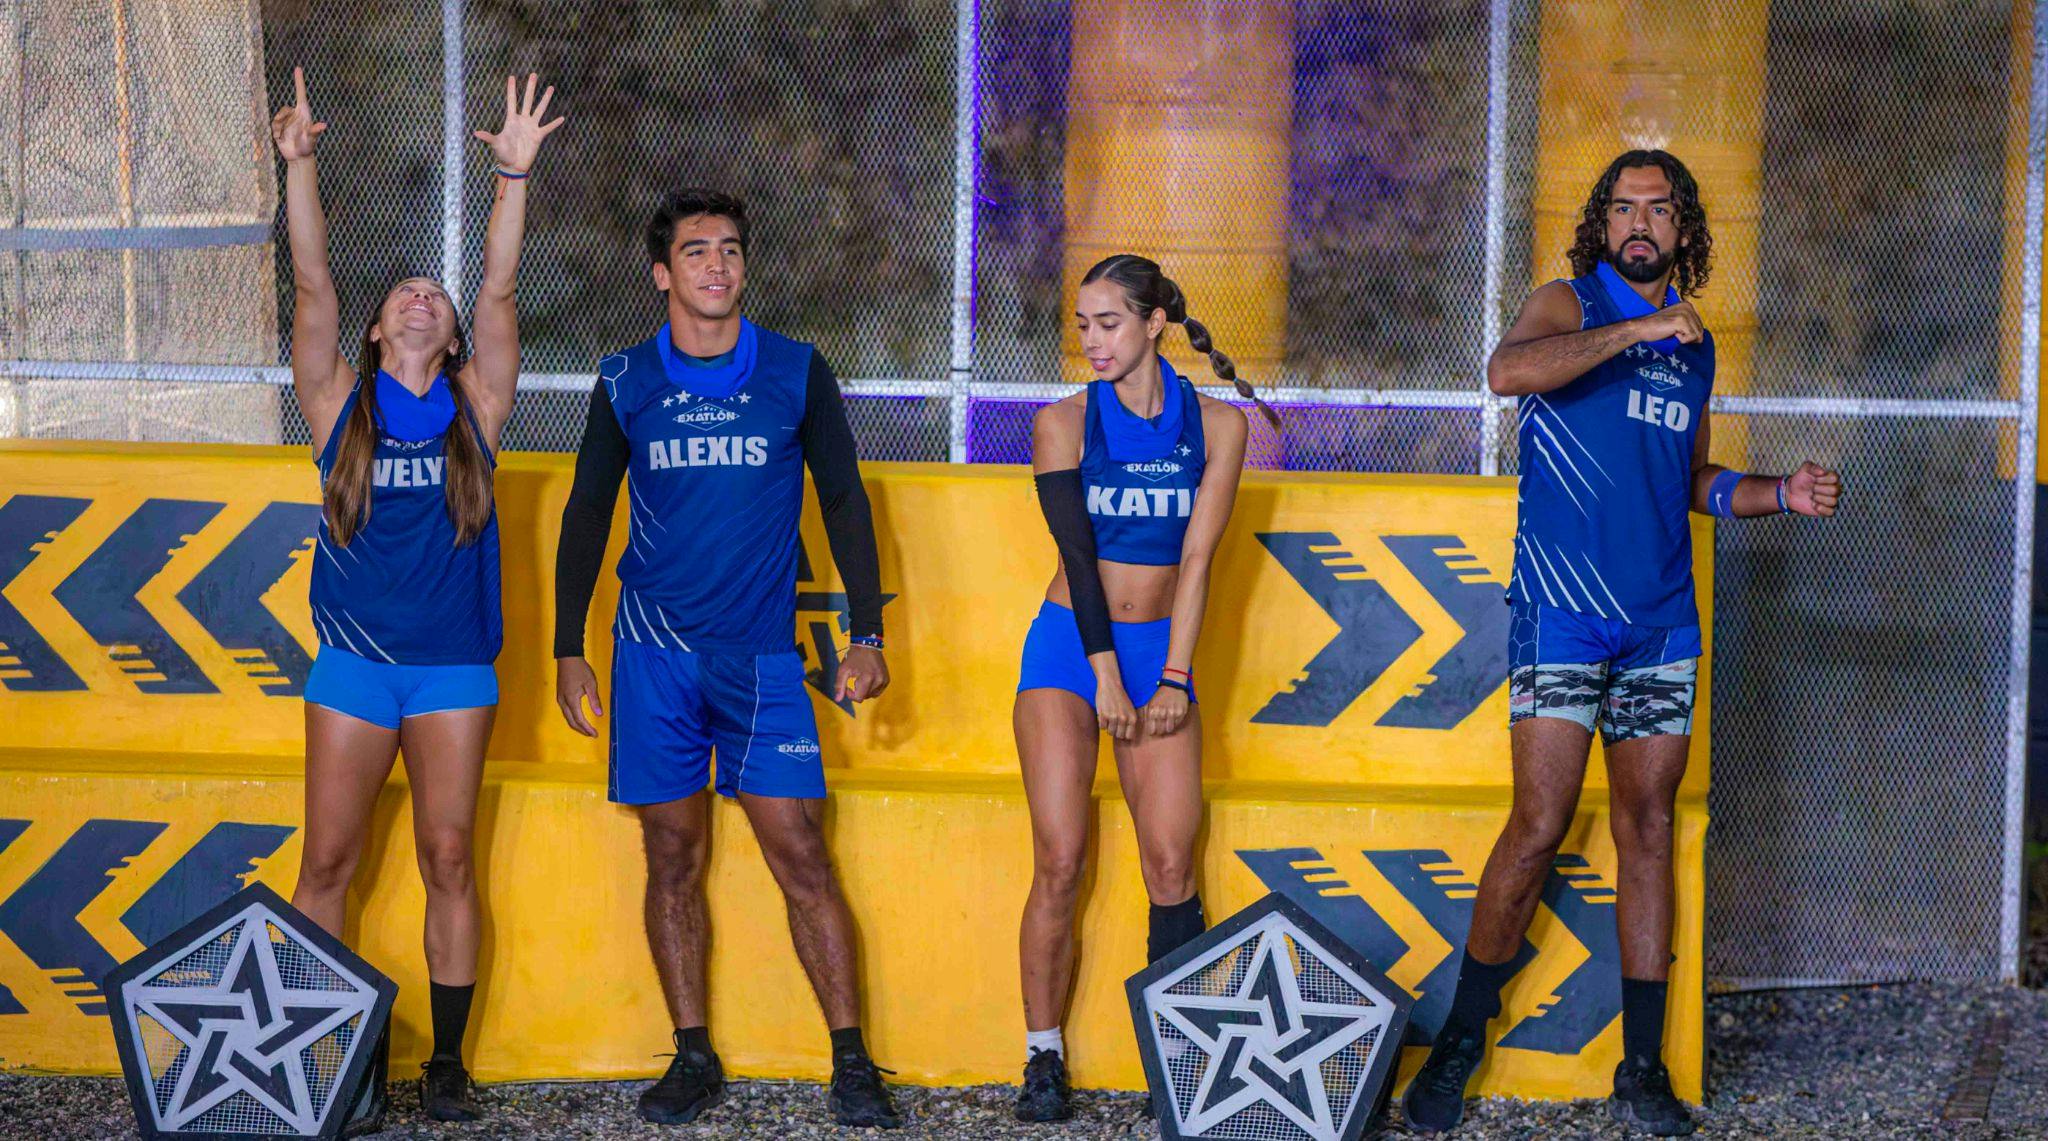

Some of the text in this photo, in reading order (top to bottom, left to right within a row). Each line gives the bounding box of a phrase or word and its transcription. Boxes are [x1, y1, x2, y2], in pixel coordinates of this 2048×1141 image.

[1626, 388, 1690, 432] LEO
[649, 436, 768, 470] ALEXIS
[371, 455, 449, 488] VELY
[1087, 485, 1200, 518] KATI
